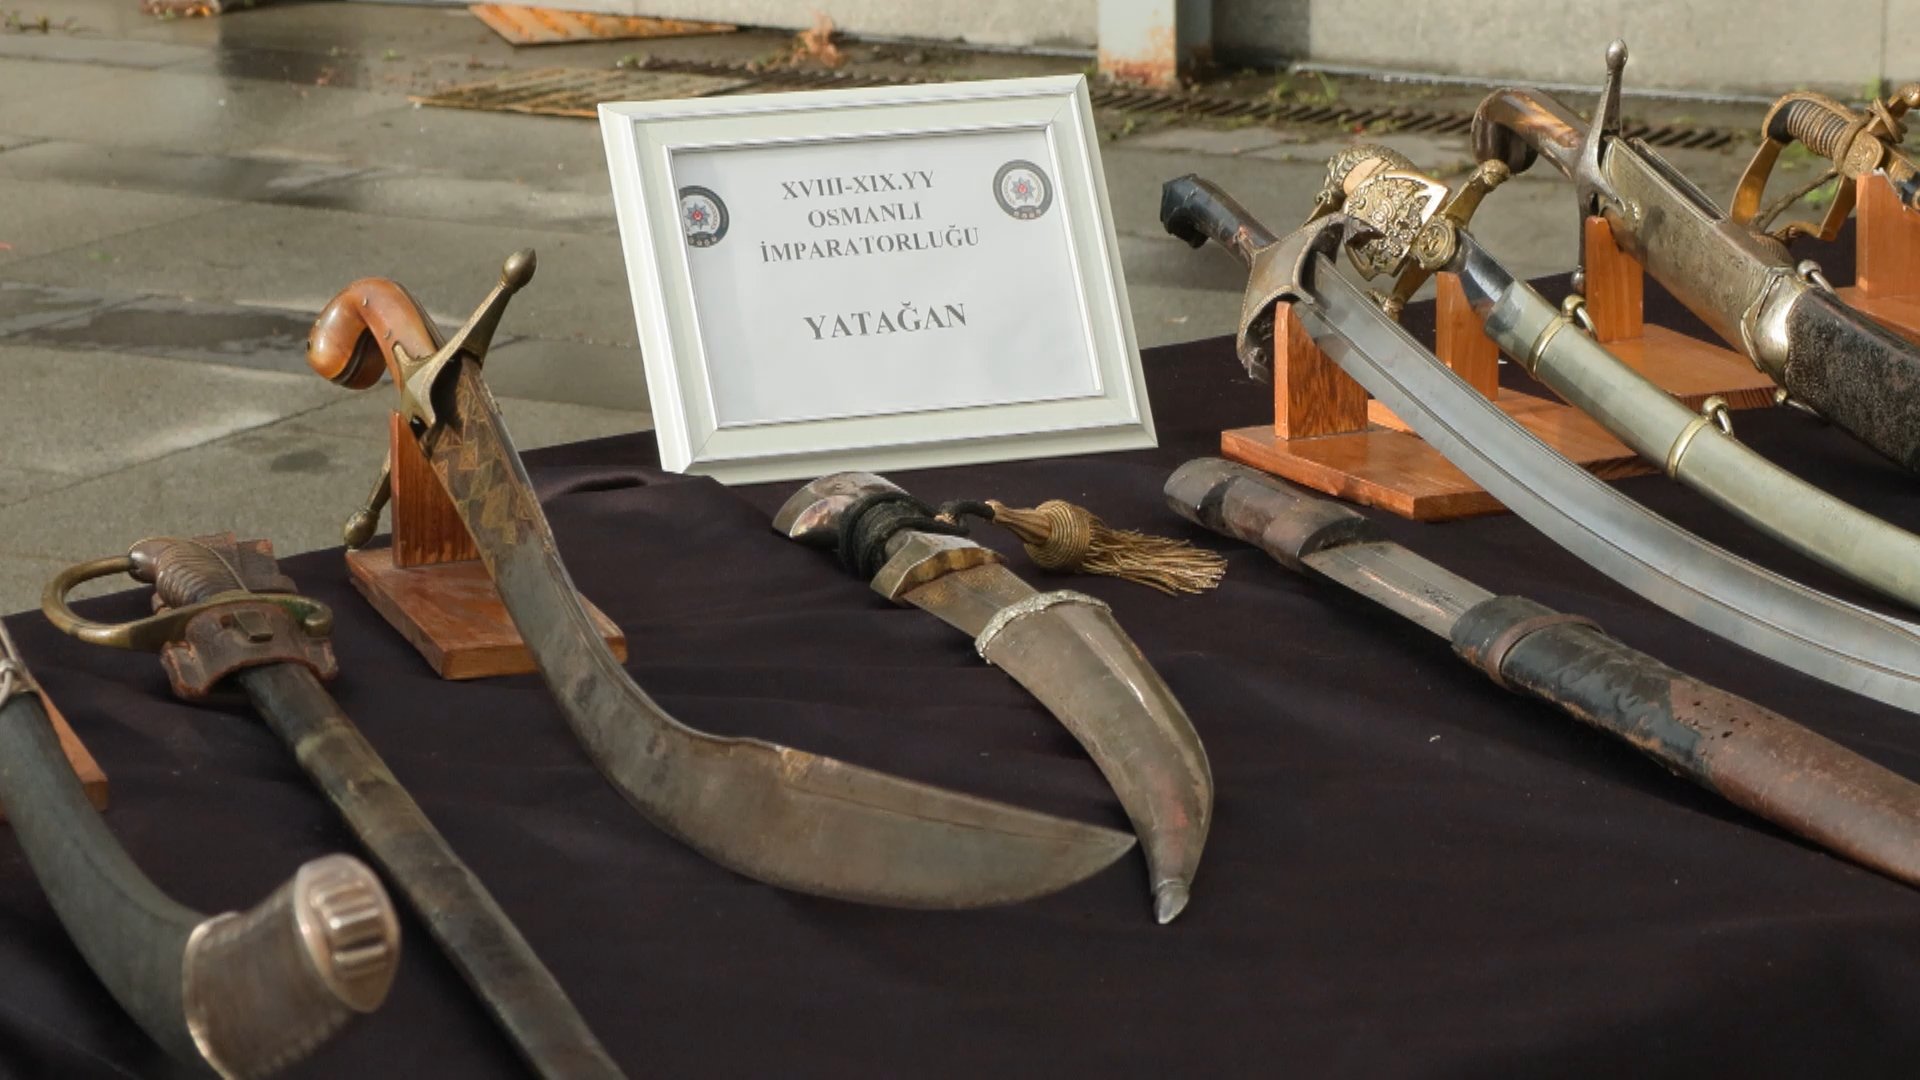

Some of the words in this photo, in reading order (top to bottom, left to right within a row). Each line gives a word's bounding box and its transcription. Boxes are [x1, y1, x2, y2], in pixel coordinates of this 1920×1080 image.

[781, 170, 935, 200] XVIII-XIX.YY
[807, 202, 923, 228] OSMANLI
[760, 224, 980, 263] İMPARATORLUĞU
[803, 301, 968, 340] YATAĞAN
